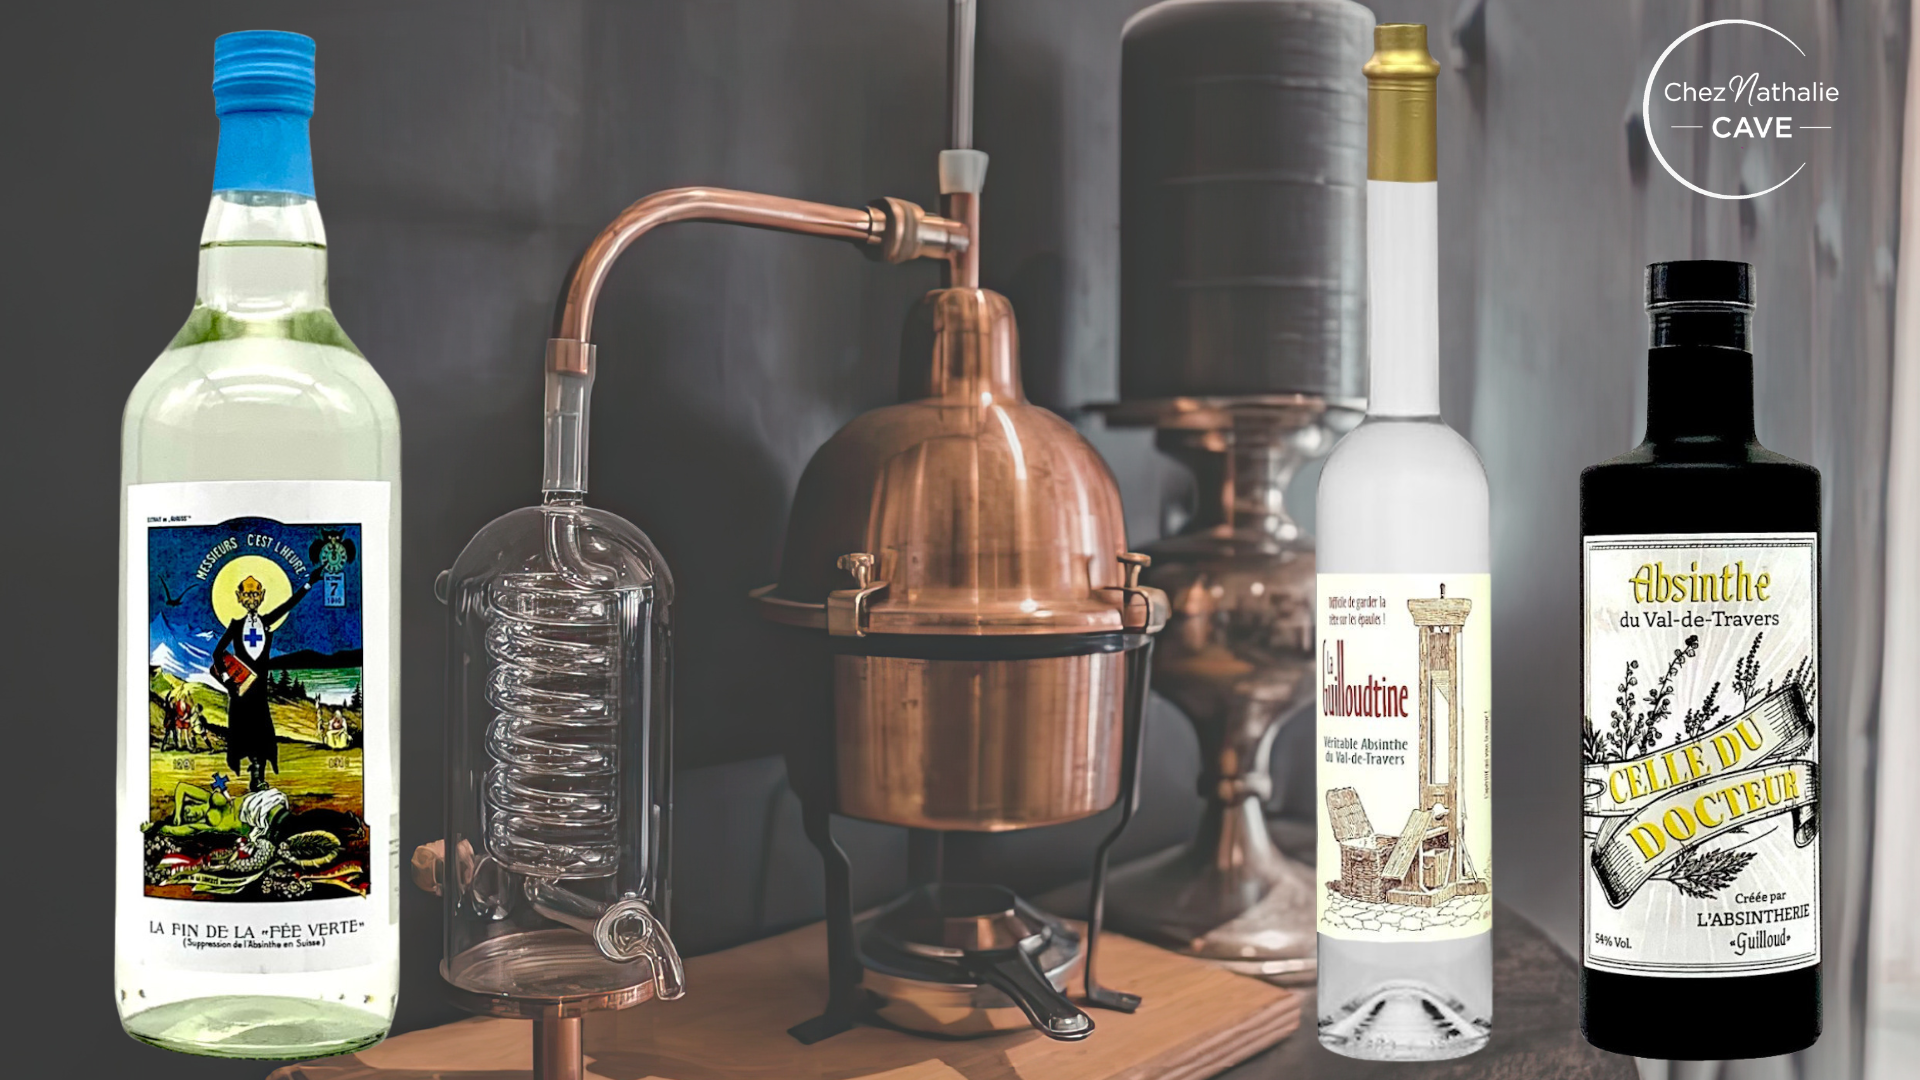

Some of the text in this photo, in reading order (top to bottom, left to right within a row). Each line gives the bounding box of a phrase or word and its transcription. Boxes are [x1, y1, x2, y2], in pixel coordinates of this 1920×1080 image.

[196, 536, 238, 580] MESSIEURS
[1628, 560, 1772, 604] Absinthe
[1348, 595, 1355, 608] de
[1356, 595, 1378, 611] garder
[1379, 595, 1386, 608] la
[1348, 613, 1356, 625] les
[1357, 613, 1381, 628] épaules
[1620, 610, 1780, 628] du Val-de-Travers
[1322, 639, 1409, 718] Guilloudtine
[1324, 735, 1408, 751] Véritable Absinthe
[1325, 751, 1405, 766] du Val-de-Travers
[1609, 713, 1765, 804] CELLE DU
[1626, 770, 1800, 864] DOCTEUR
[1735, 891, 1786, 905] Créée par
[1697, 903, 1810, 927] L'ABSINTHERIE
[150, 920, 164, 934] LA
[172, 923, 199, 937] FIN
[206, 925, 229, 938] DE
[234, 925, 255, 939] LA
[1595, 932, 1632, 949] 54% Vol.
